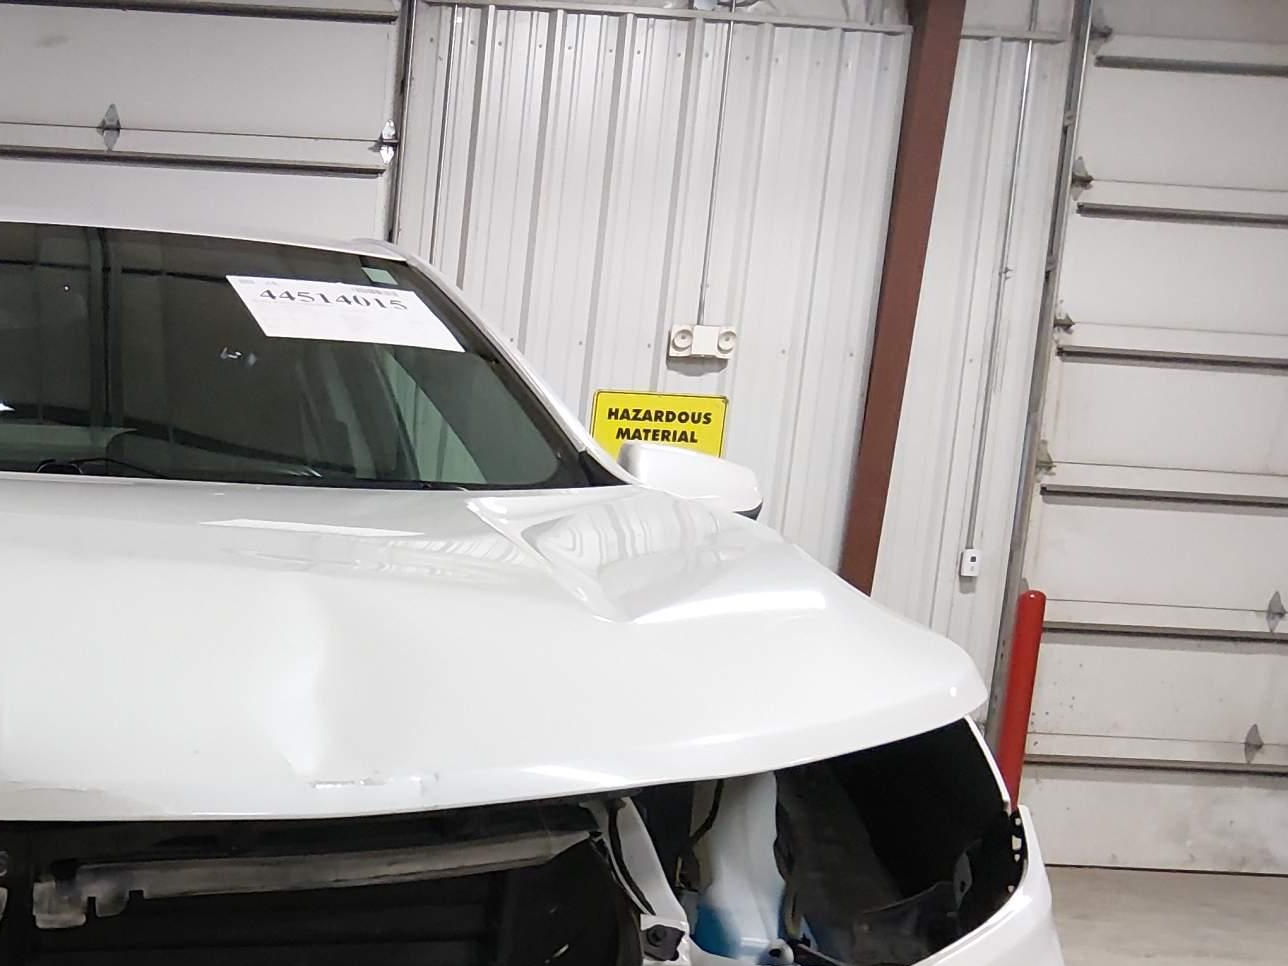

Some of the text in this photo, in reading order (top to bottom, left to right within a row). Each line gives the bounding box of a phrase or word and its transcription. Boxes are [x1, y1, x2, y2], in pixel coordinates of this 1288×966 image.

[260, 288, 408, 310] 44514015
[607, 407, 712, 425] HAZARDOUS
[616, 428, 698, 444] MATERIAL
